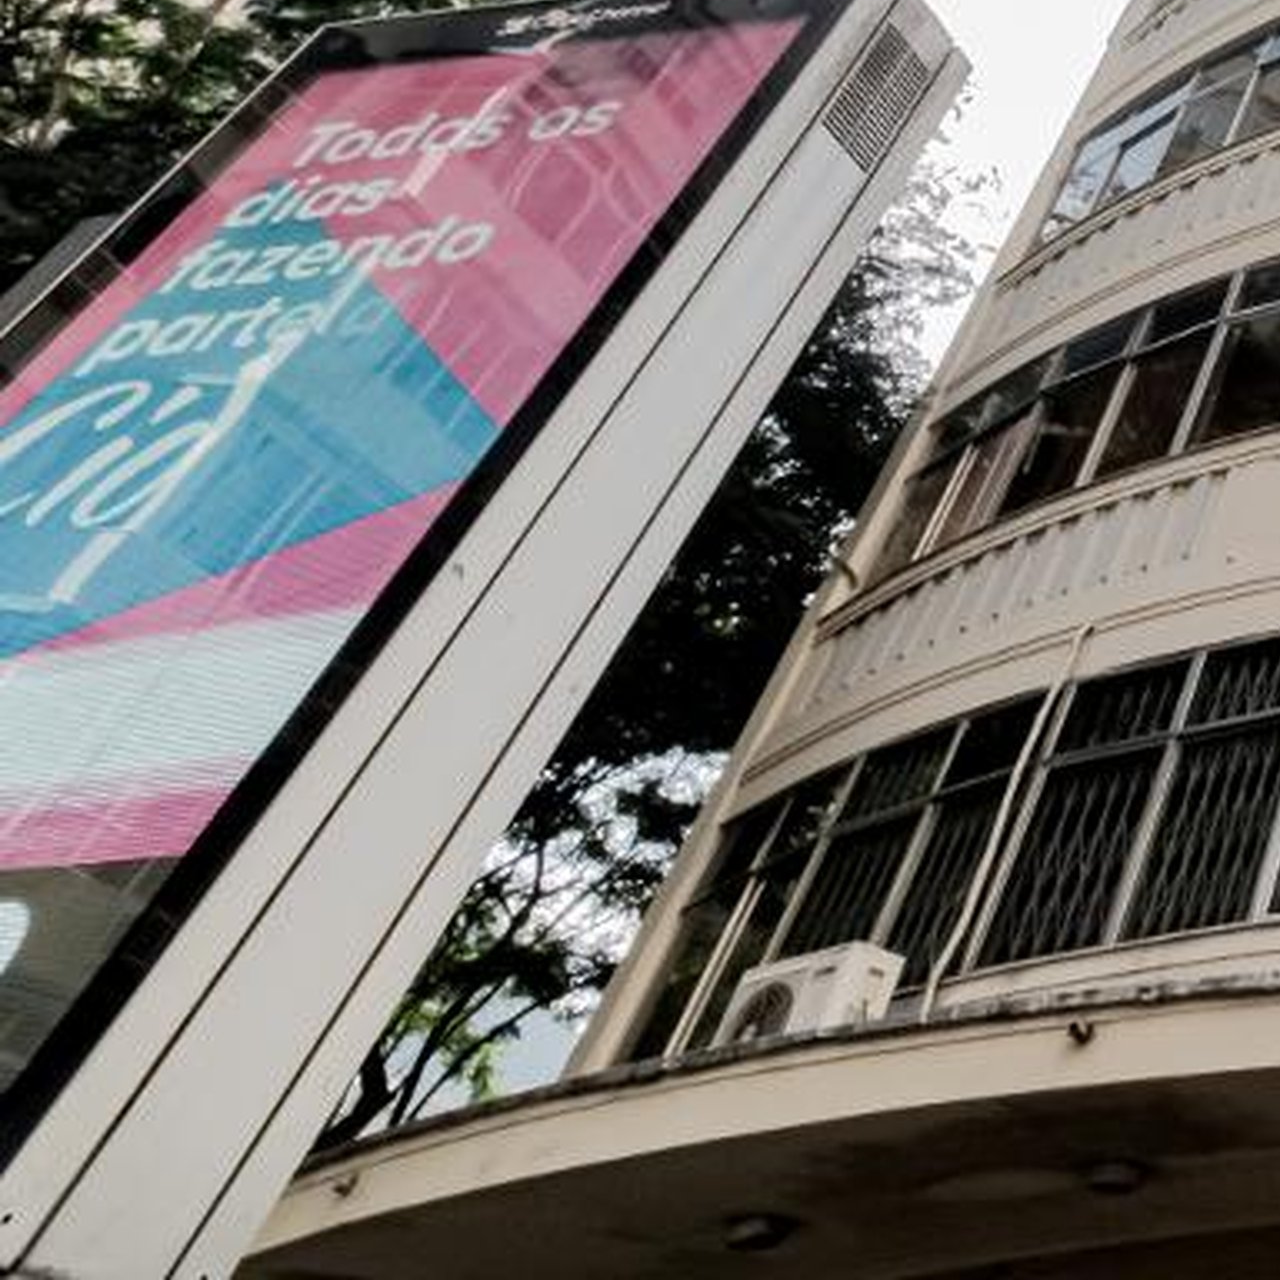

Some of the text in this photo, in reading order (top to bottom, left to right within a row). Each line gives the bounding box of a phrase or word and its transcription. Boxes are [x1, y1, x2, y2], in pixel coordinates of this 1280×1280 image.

[529, 101, 622, 140] os
[226, 176, 397, 227] dias
[160, 216, 494, 294] fazendo
